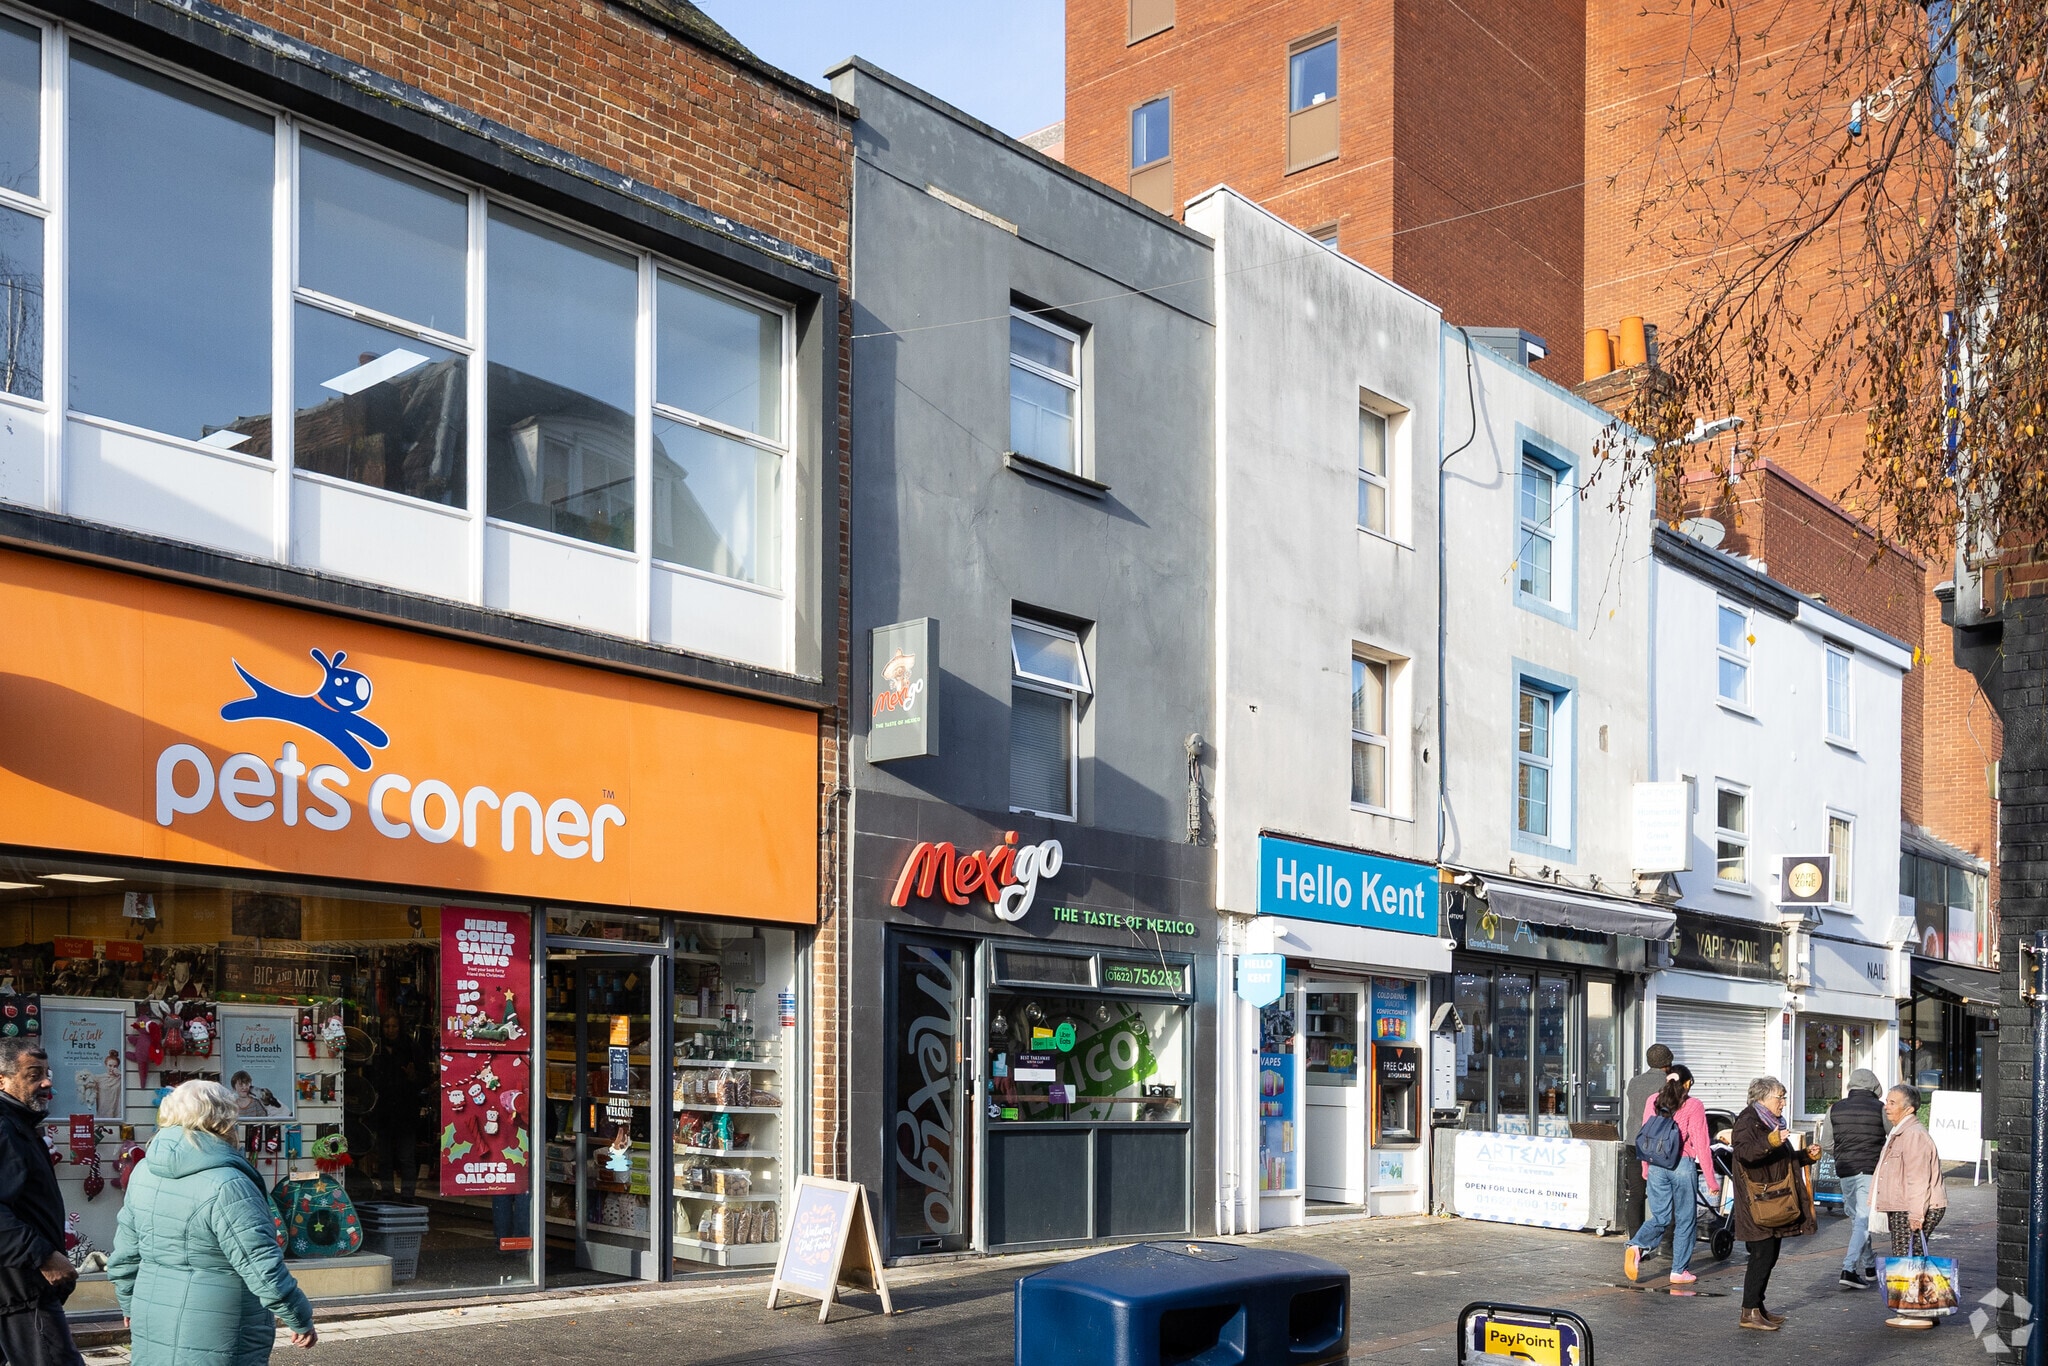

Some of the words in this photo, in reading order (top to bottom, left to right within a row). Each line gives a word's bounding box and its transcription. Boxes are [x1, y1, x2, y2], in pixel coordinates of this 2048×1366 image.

[872, 678, 923, 717] Mexigo
[602, 789, 615, 800] TM
[156, 741, 351, 831] pets
[367, 773, 626, 863] corner
[890, 830, 1063, 922] Mexigo
[1794, 872, 1816, 881] VAPE
[1276, 857, 1352, 908] Hello
[1361, 871, 1425, 919] Kent
[1794, 880, 1816, 888] ZONE
[464, 918, 507, 932] HERE
[1053, 907, 1079, 923] THE
[1083, 910, 1121, 928] TASTE
[1125, 915, 1143, 930] OF
[1147, 917, 1195, 935] MEXICO
[456, 930, 515, 944] COMES
[458, 941, 513, 956] SANTA
[1696, 933, 1726, 959] VAPE
[1730, 938, 1760, 963] ZONE
[462, 953, 510, 967] PAWS
[1244, 959, 1273, 969] HELLO
[1867, 961, 1886, 980] NAIL
[276, 970, 292, 983] AND
[295, 968, 319, 988] MIX
[1105, 969, 1133, 984] (01622)
[1133, 968, 1182, 987] 756283
[1247, 973, 1272, 983] KENT
[457, 980, 479, 990] HO
[458, 991, 480, 1004] HO
[456, 1003, 478, 1015] HO
[62, 1027, 85, 1041] Let's
[86, 1029, 104, 1041] talk
[240, 1033, 260, 1045] Let's
[261, 1033, 277, 1045] talk
[72, 1040, 96, 1049] Farts
[235, 1043, 252, 1052] Bad
[254, 1043, 282, 1053] Breath
[1260, 1057, 1281, 1067] VAPES
[1383, 1061, 1397, 1071] FREE
[1397, 1062, 1415, 1072] CASH
[608, 1097, 618, 1106] ALL
[618, 1098, 631, 1107] PETS
[605, 1105, 634, 1118] WELCOME
[1936, 1118, 1969, 1130] NAIL
[463, 1162, 507, 1173] GIFTS
[455, 1173, 516, 1184] GALORE
[1465, 1182, 1486, 1190] OPEN
[1489, 1184, 1505, 1192] FOR
[1507, 1186, 1535, 1195] LUNCH
[1546, 1190, 1578, 1199] DINNER
[1490, 1330, 1555, 1348] PayPoint
